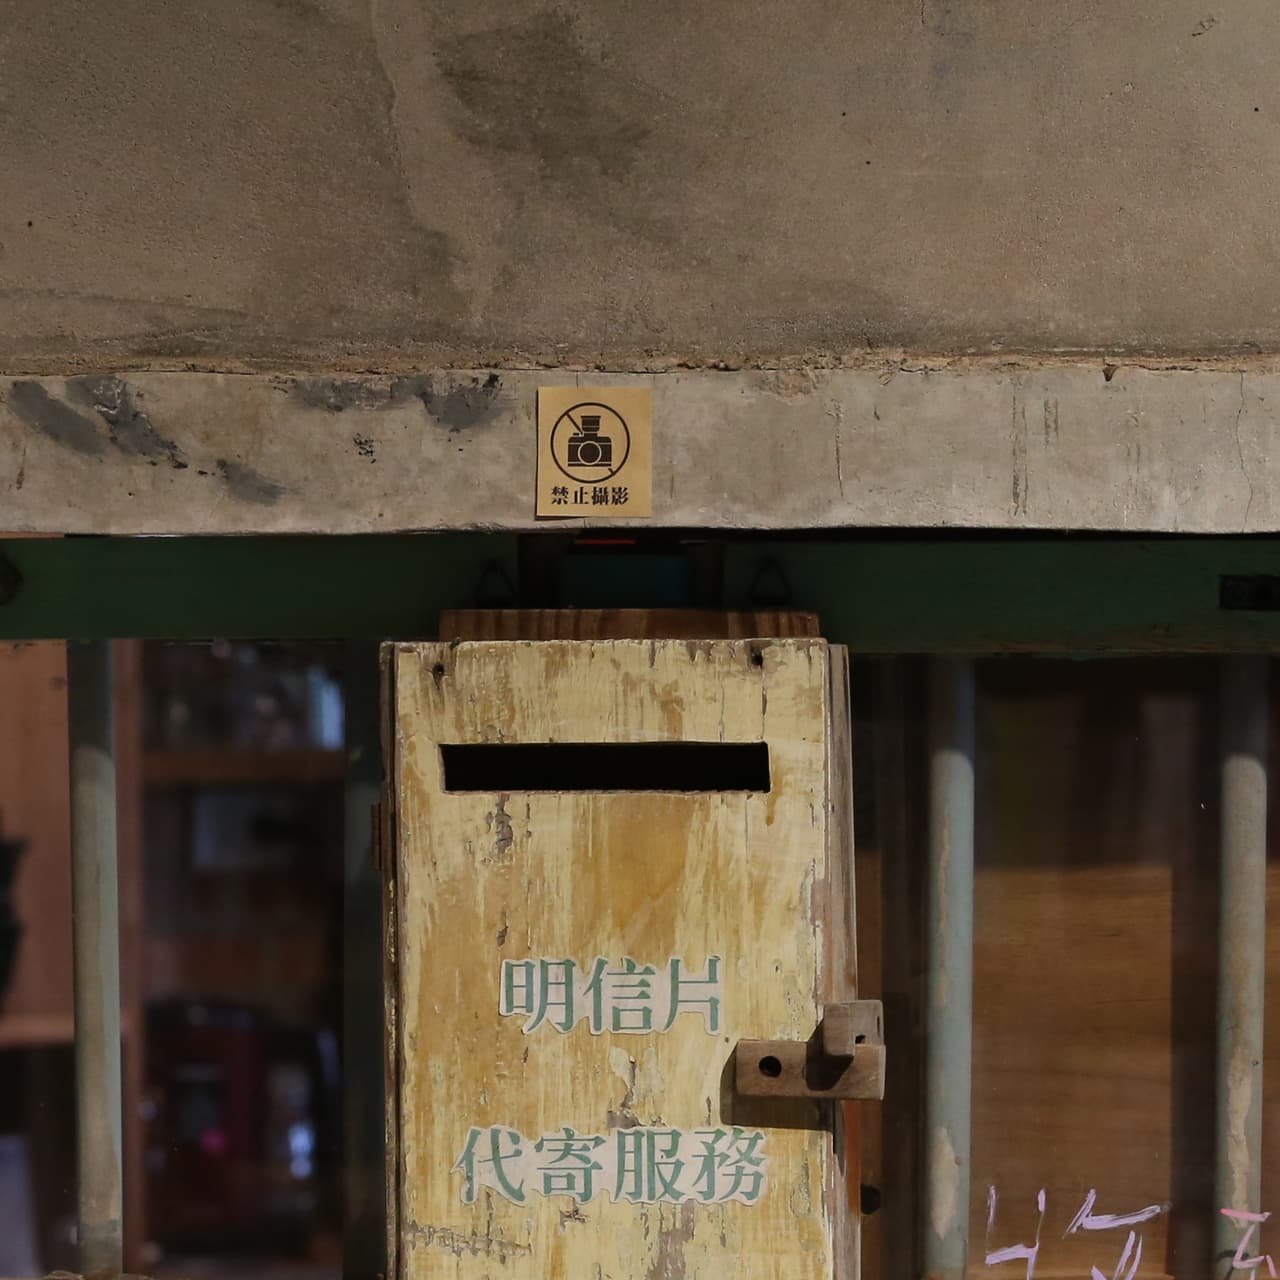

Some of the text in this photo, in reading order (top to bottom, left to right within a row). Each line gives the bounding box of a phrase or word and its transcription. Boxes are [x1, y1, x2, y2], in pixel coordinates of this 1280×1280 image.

[551, 486, 629, 505] 禁止攝影
[503, 956, 720, 1034] 明信片
[455, 1127, 767, 1204] 代寄服務
